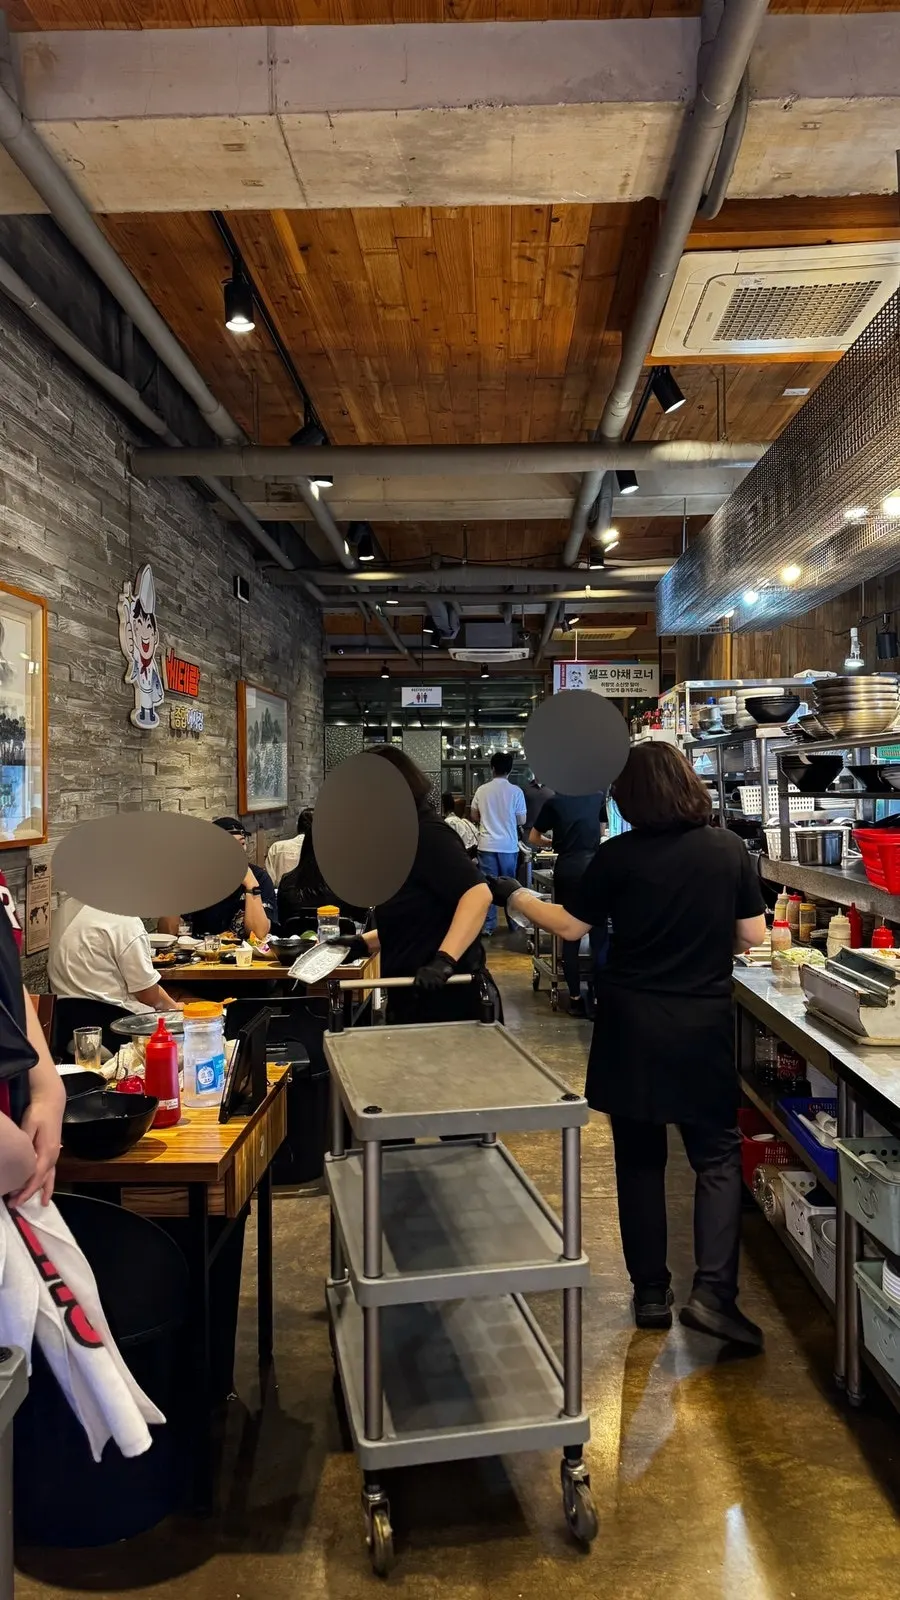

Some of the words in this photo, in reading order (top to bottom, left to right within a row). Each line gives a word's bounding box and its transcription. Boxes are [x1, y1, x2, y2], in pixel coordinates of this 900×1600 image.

[587, 669, 608, 680] 셀프
[610, 669, 631, 680] 야채
[633, 669, 653, 680] 코너
